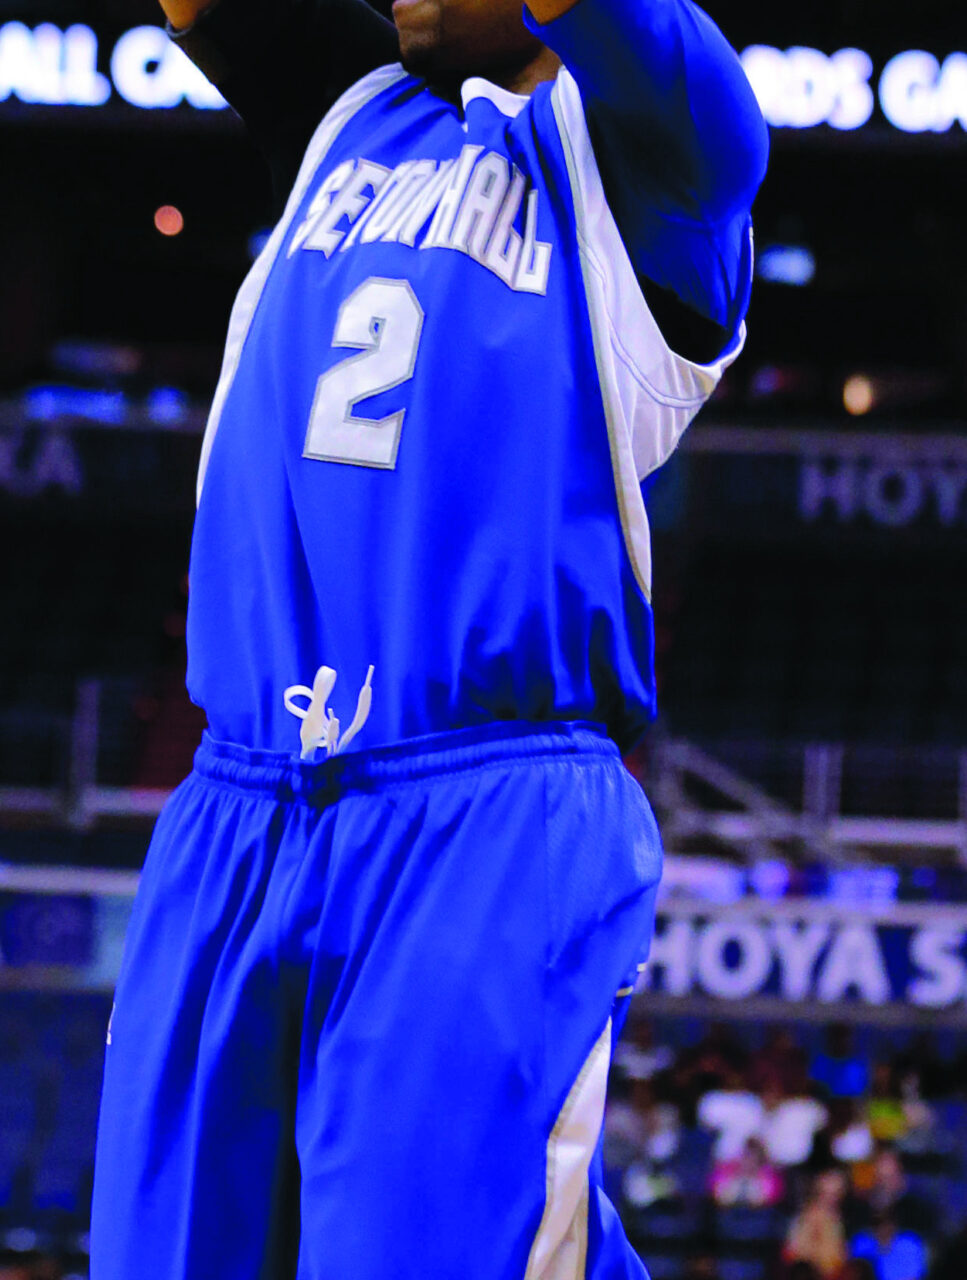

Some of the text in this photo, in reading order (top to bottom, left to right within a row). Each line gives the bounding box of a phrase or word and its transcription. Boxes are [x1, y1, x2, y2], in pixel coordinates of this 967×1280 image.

[285, 143, 553, 297] SETON HALL
[302, 277, 424, 470] 2
[632, 917, 893, 1007] HOYA
